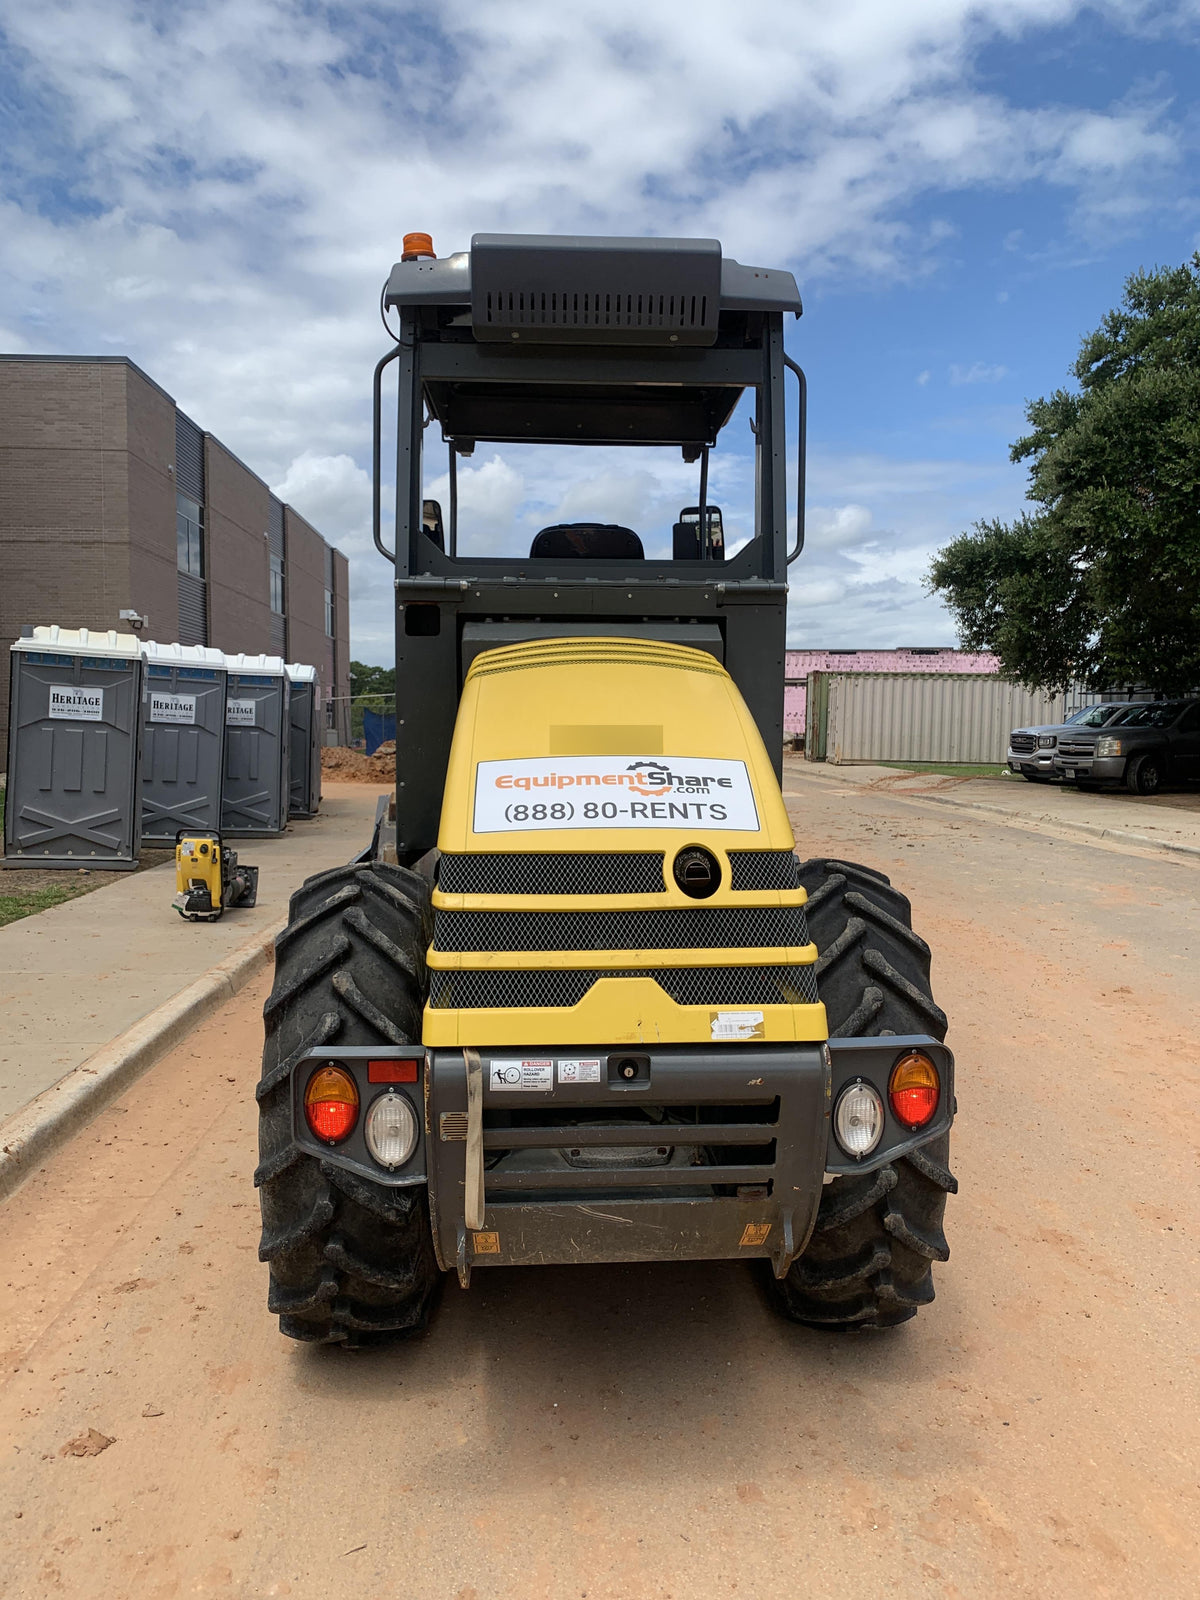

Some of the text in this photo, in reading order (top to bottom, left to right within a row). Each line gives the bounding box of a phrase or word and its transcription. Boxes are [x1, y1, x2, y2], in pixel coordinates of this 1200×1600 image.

[52, 693, 100, 706] HERITAGE
[153, 700, 193, 711] HERITAGE
[495, 771, 732, 790] EquipmentShare
[672, 786, 710, 795] .com
[504, 802, 728, 823] (888) 80-RENTS
